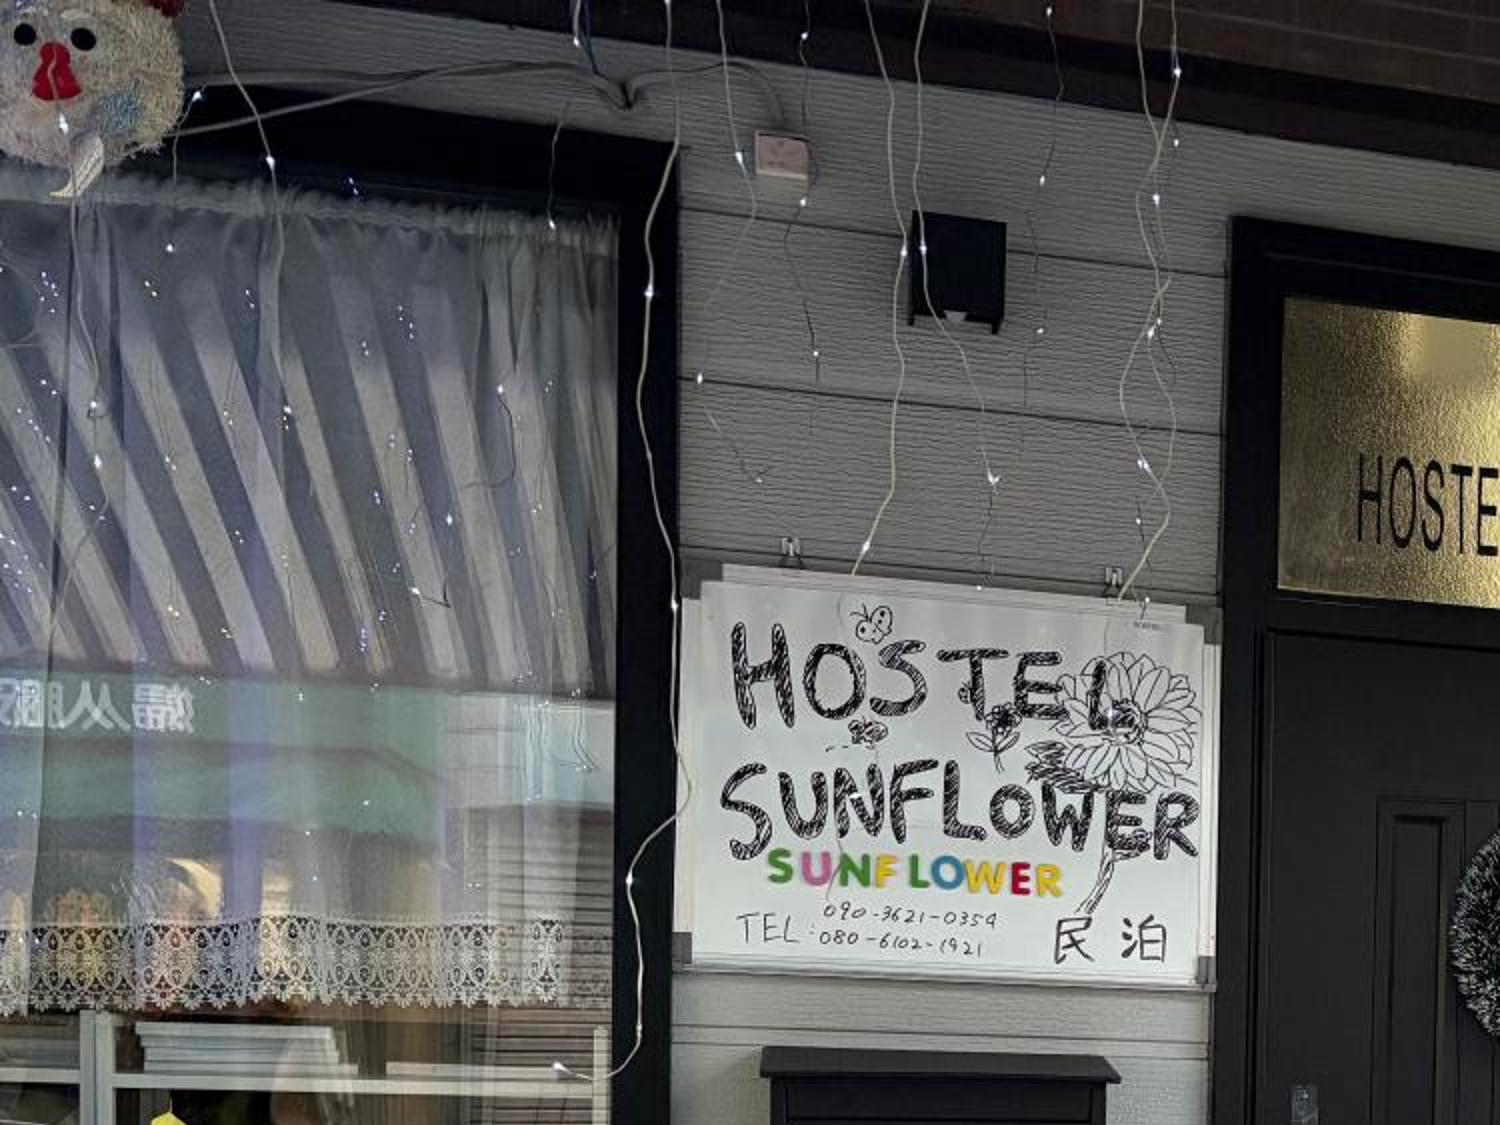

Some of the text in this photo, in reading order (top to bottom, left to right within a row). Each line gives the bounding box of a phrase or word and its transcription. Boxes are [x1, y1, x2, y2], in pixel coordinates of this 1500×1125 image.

[731, 622, 1120, 730] HOSTEL
[720, 760, 1199, 861] SUNFLOWER
[767, 848, 1063, 898] SUNFLOWER
[1054, 914, 1167, 964] 民泊
